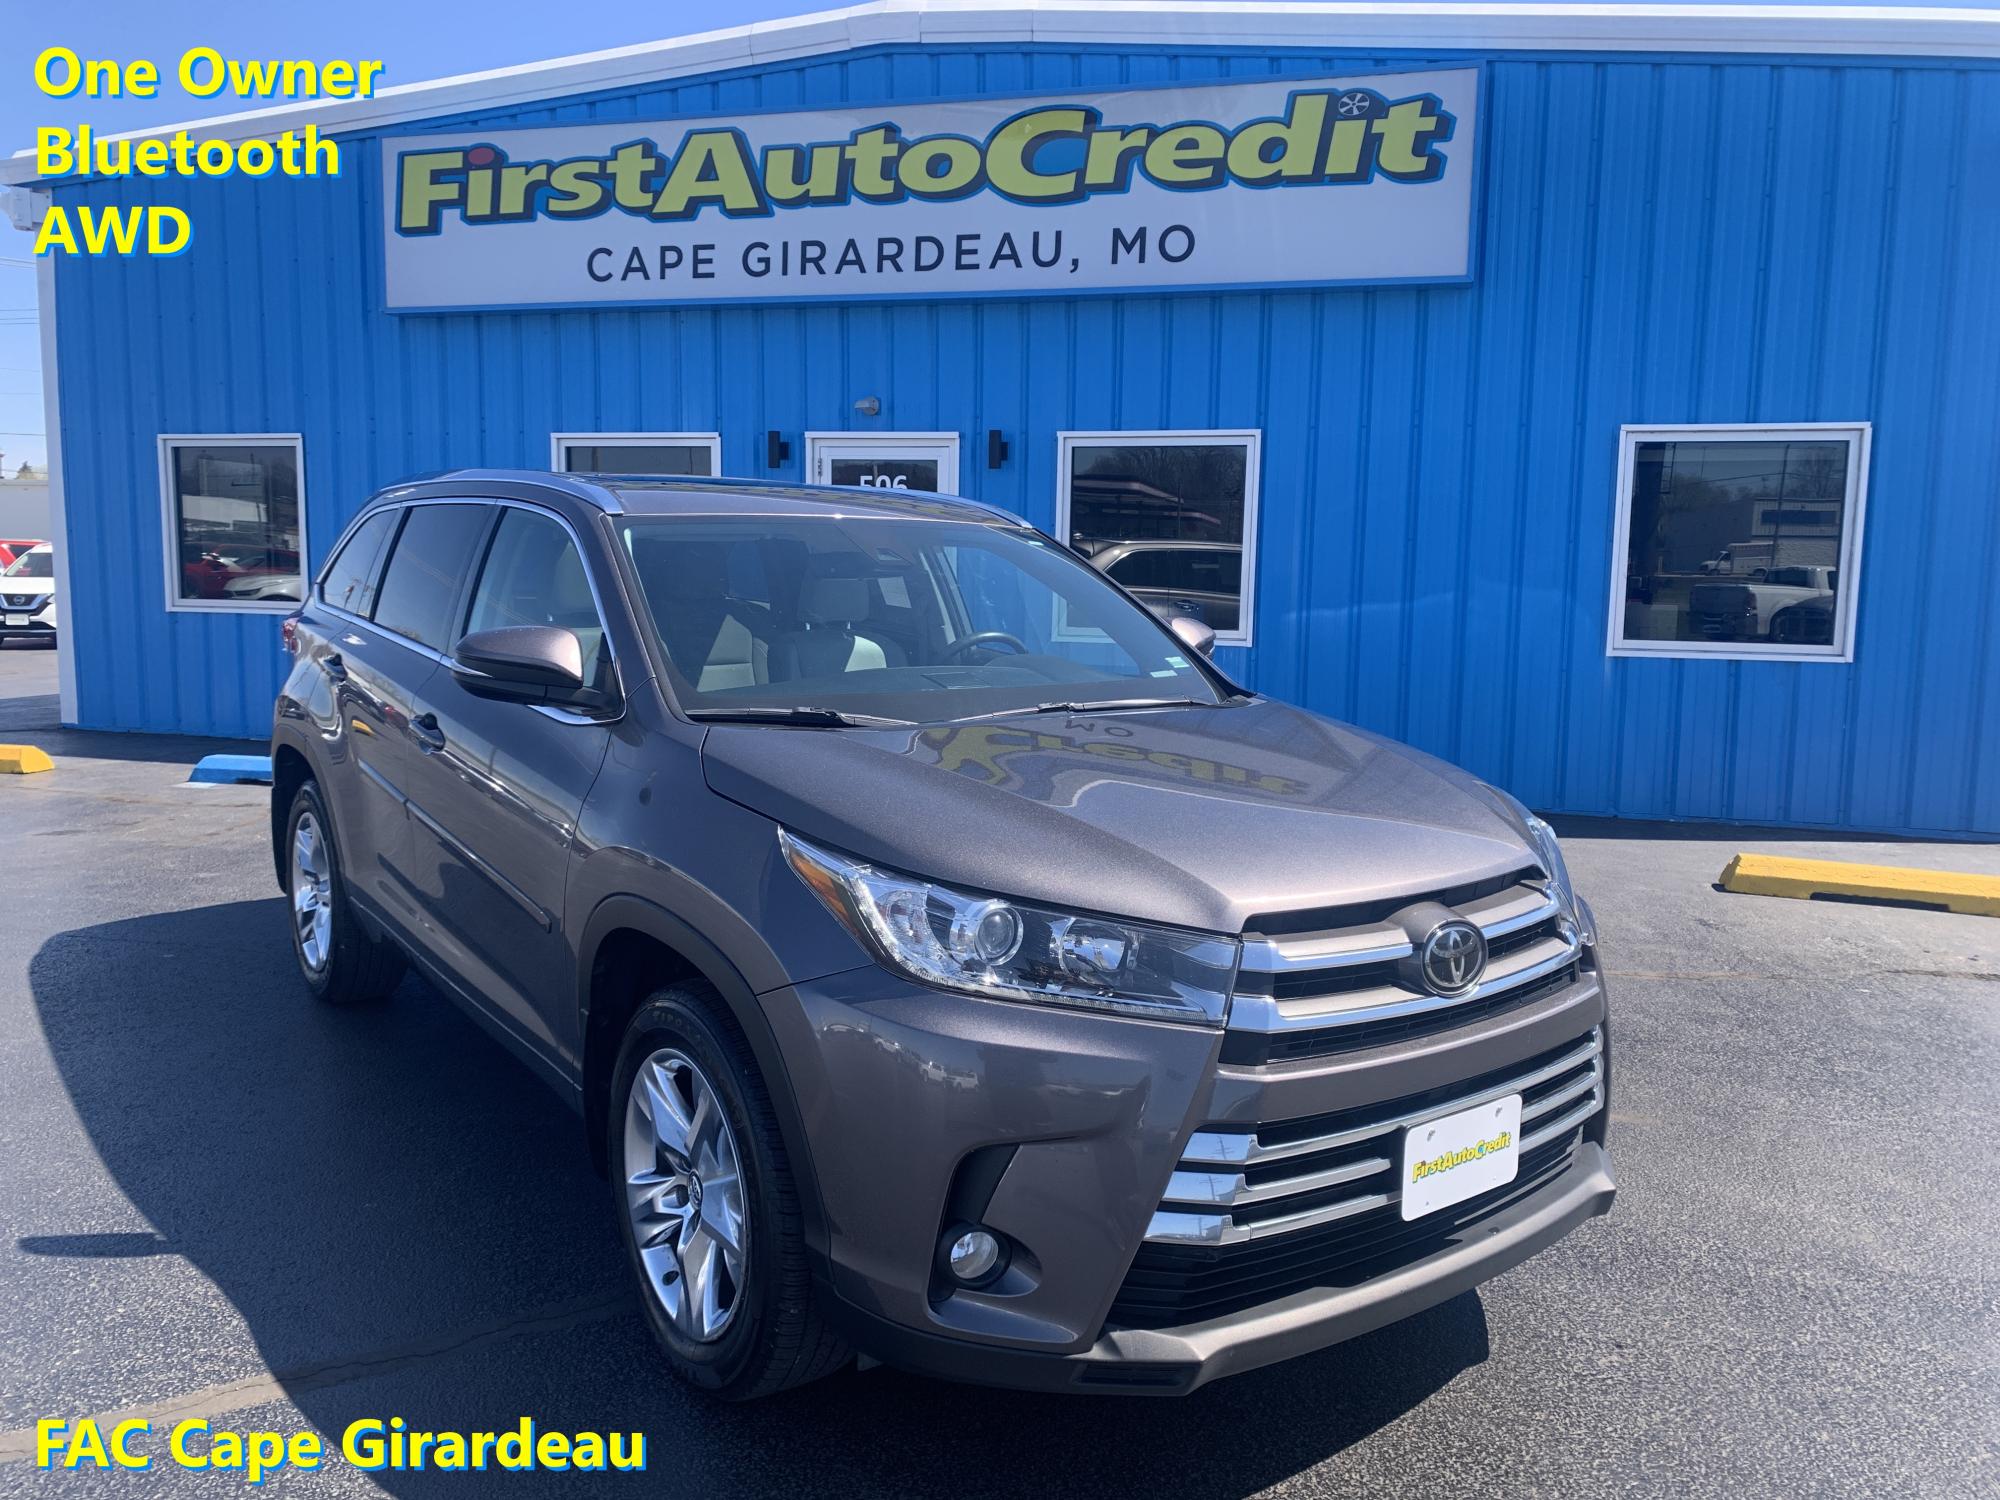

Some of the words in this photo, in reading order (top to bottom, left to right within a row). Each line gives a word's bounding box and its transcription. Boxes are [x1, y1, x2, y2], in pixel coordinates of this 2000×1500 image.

[397, 90, 1455, 235] FirstAutoCredit
[586, 243, 717, 283] CAPE
[741, 230, 1080, 278] GIRARDEAU,
[1110, 224, 1196, 265] MO
[1412, 1131, 1511, 1183] FirstAutoCredit
